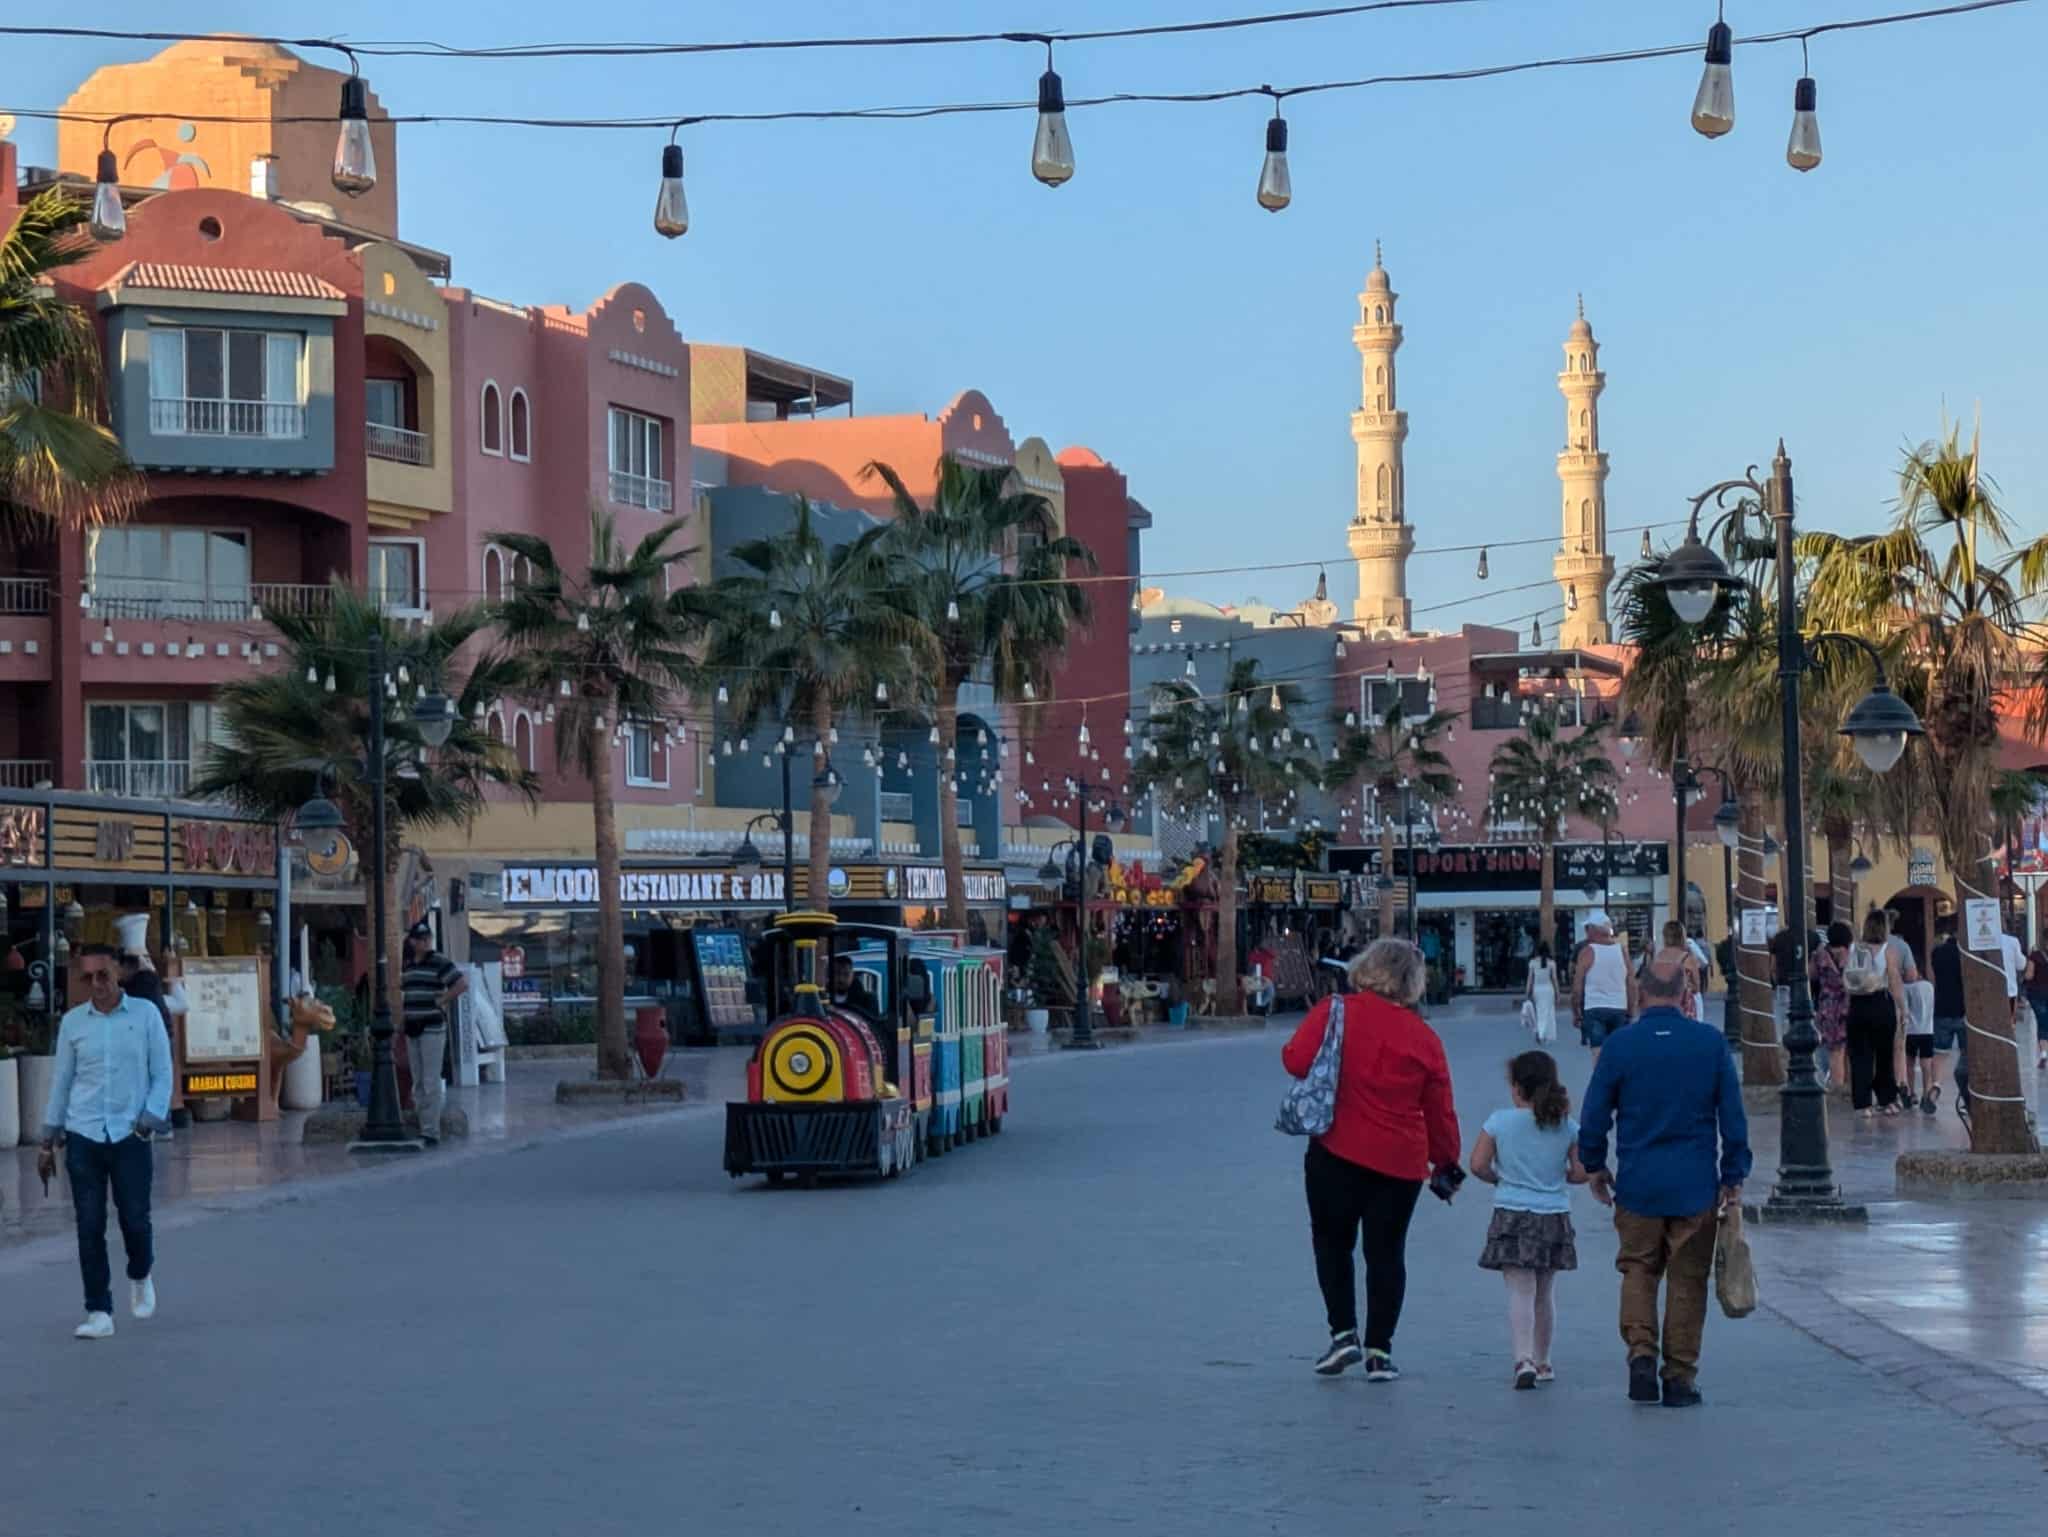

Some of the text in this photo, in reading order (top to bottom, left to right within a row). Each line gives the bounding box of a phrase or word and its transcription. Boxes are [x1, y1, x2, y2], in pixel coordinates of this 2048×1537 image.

[502, 868, 600, 901] EMOO
[731, 875, 744, 899] &
[751, 873, 784, 900] BAR
[906, 867, 947, 899] THEMOO
[188, 1075, 224, 1091] ARABIAN
